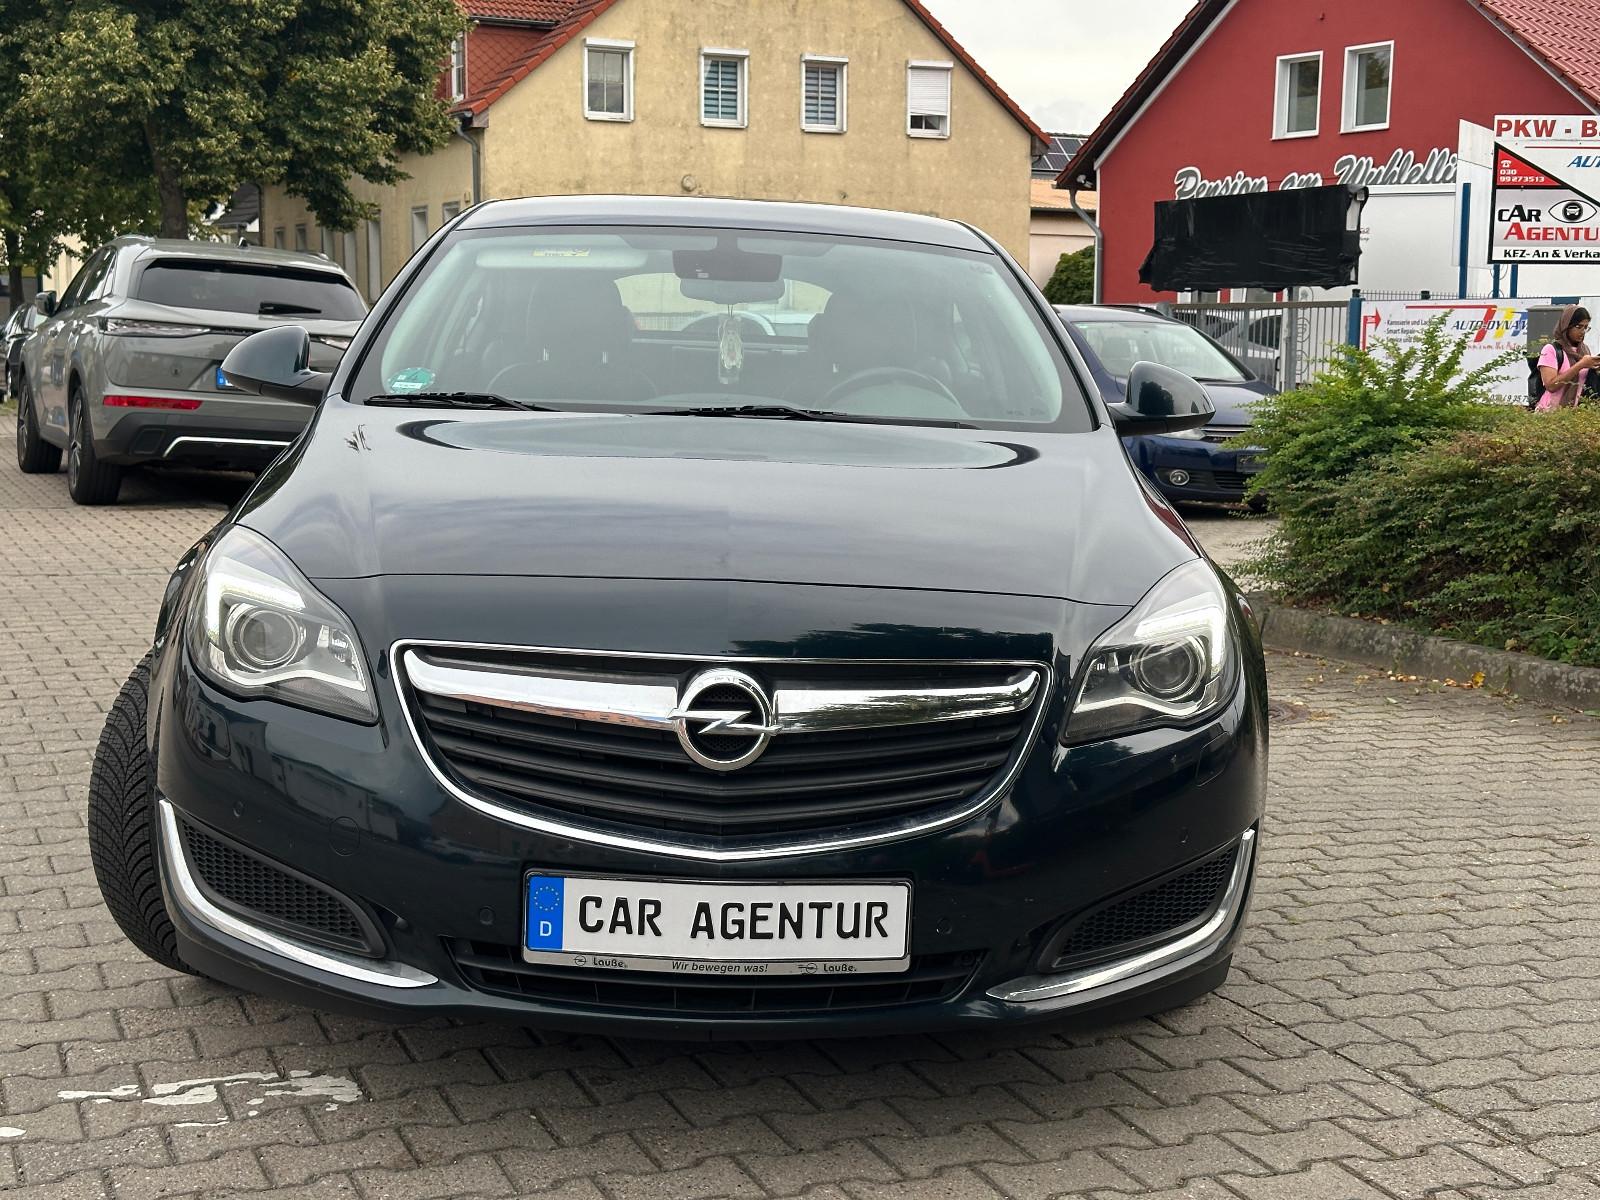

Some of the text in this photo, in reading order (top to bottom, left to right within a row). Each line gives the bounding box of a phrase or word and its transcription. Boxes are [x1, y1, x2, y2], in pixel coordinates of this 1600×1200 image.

[1495, 119, 1557, 138] PKW
[1581, 119, 1600, 138] B
[1174, 166, 1269, 201] Pension
[1551, 249, 1561, 259] &
[578, 895, 889, 940] CAR AGENTUR
[539, 920, 553, 937] D
[671, 961, 690, 972] Wir
[691, 961, 740, 974] bewegen
[744, 963, 768, 973] was!
